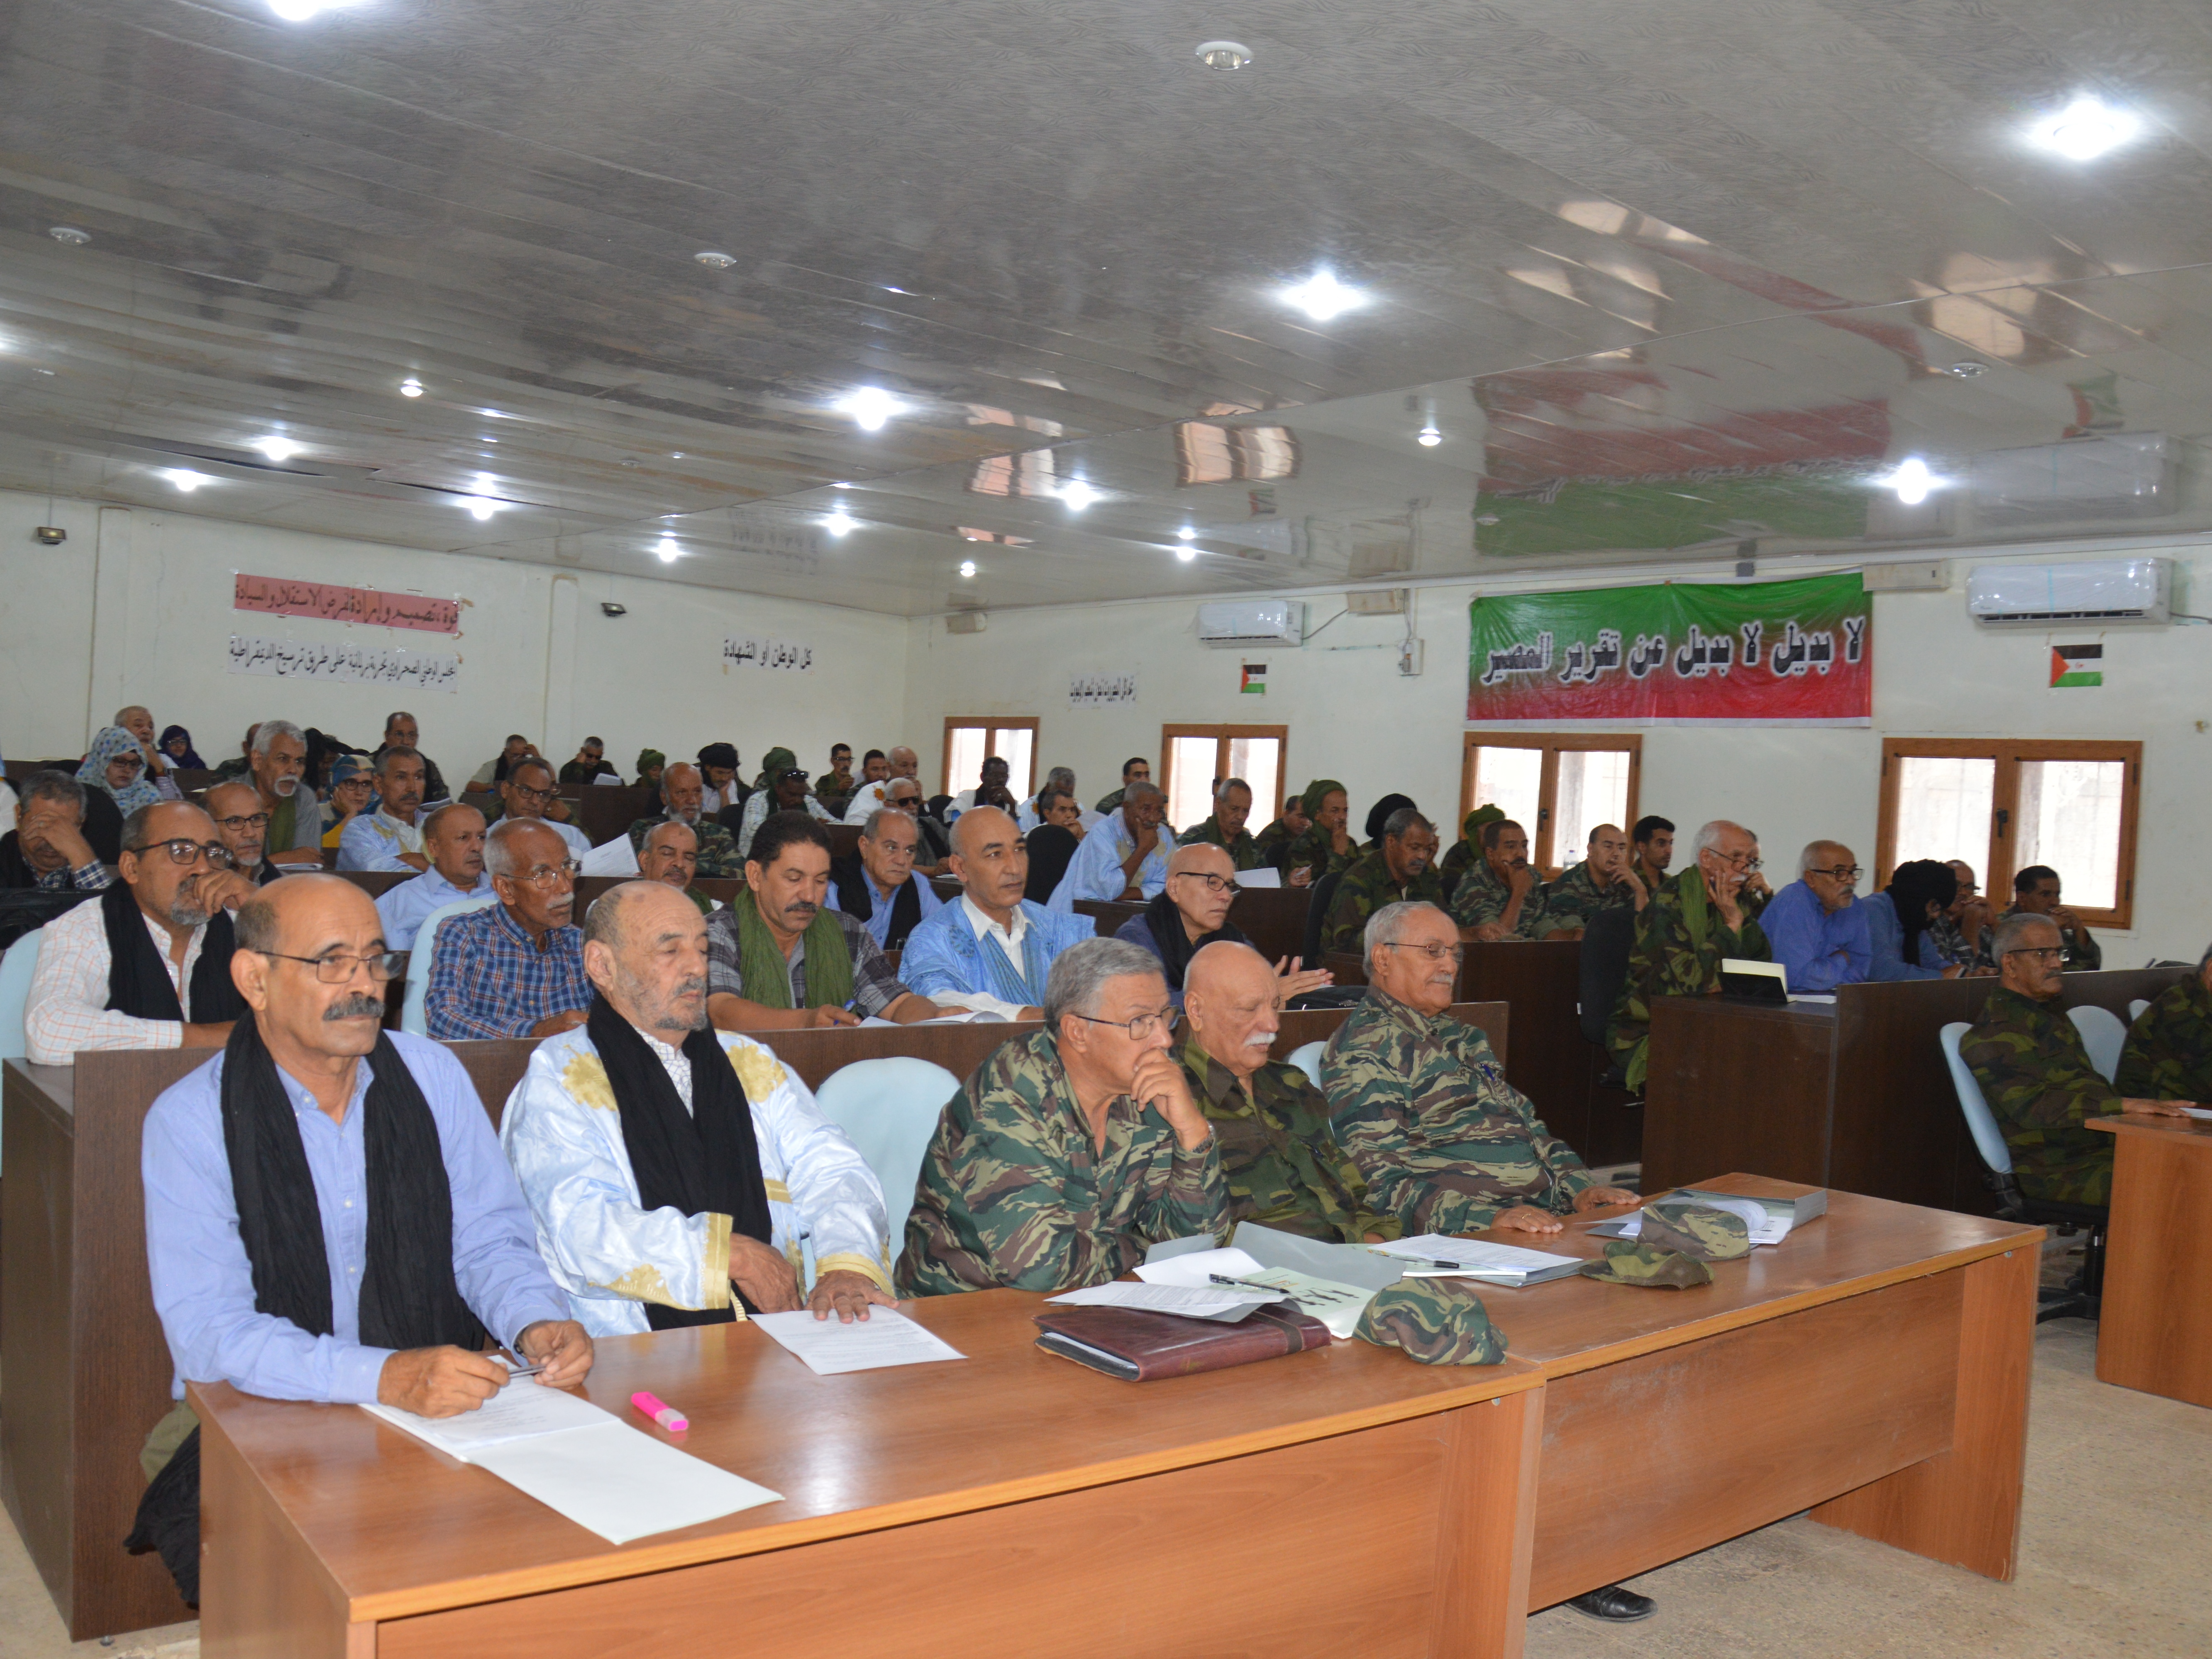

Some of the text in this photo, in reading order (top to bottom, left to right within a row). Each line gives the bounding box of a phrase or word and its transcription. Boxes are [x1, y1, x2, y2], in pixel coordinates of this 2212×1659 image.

[723, 639, 757, 665] الشهادة
[772, 644, 798, 669] الوطن
[1482, 619, 1864, 683] لا بديل لا بديل عن تقرير المصير
